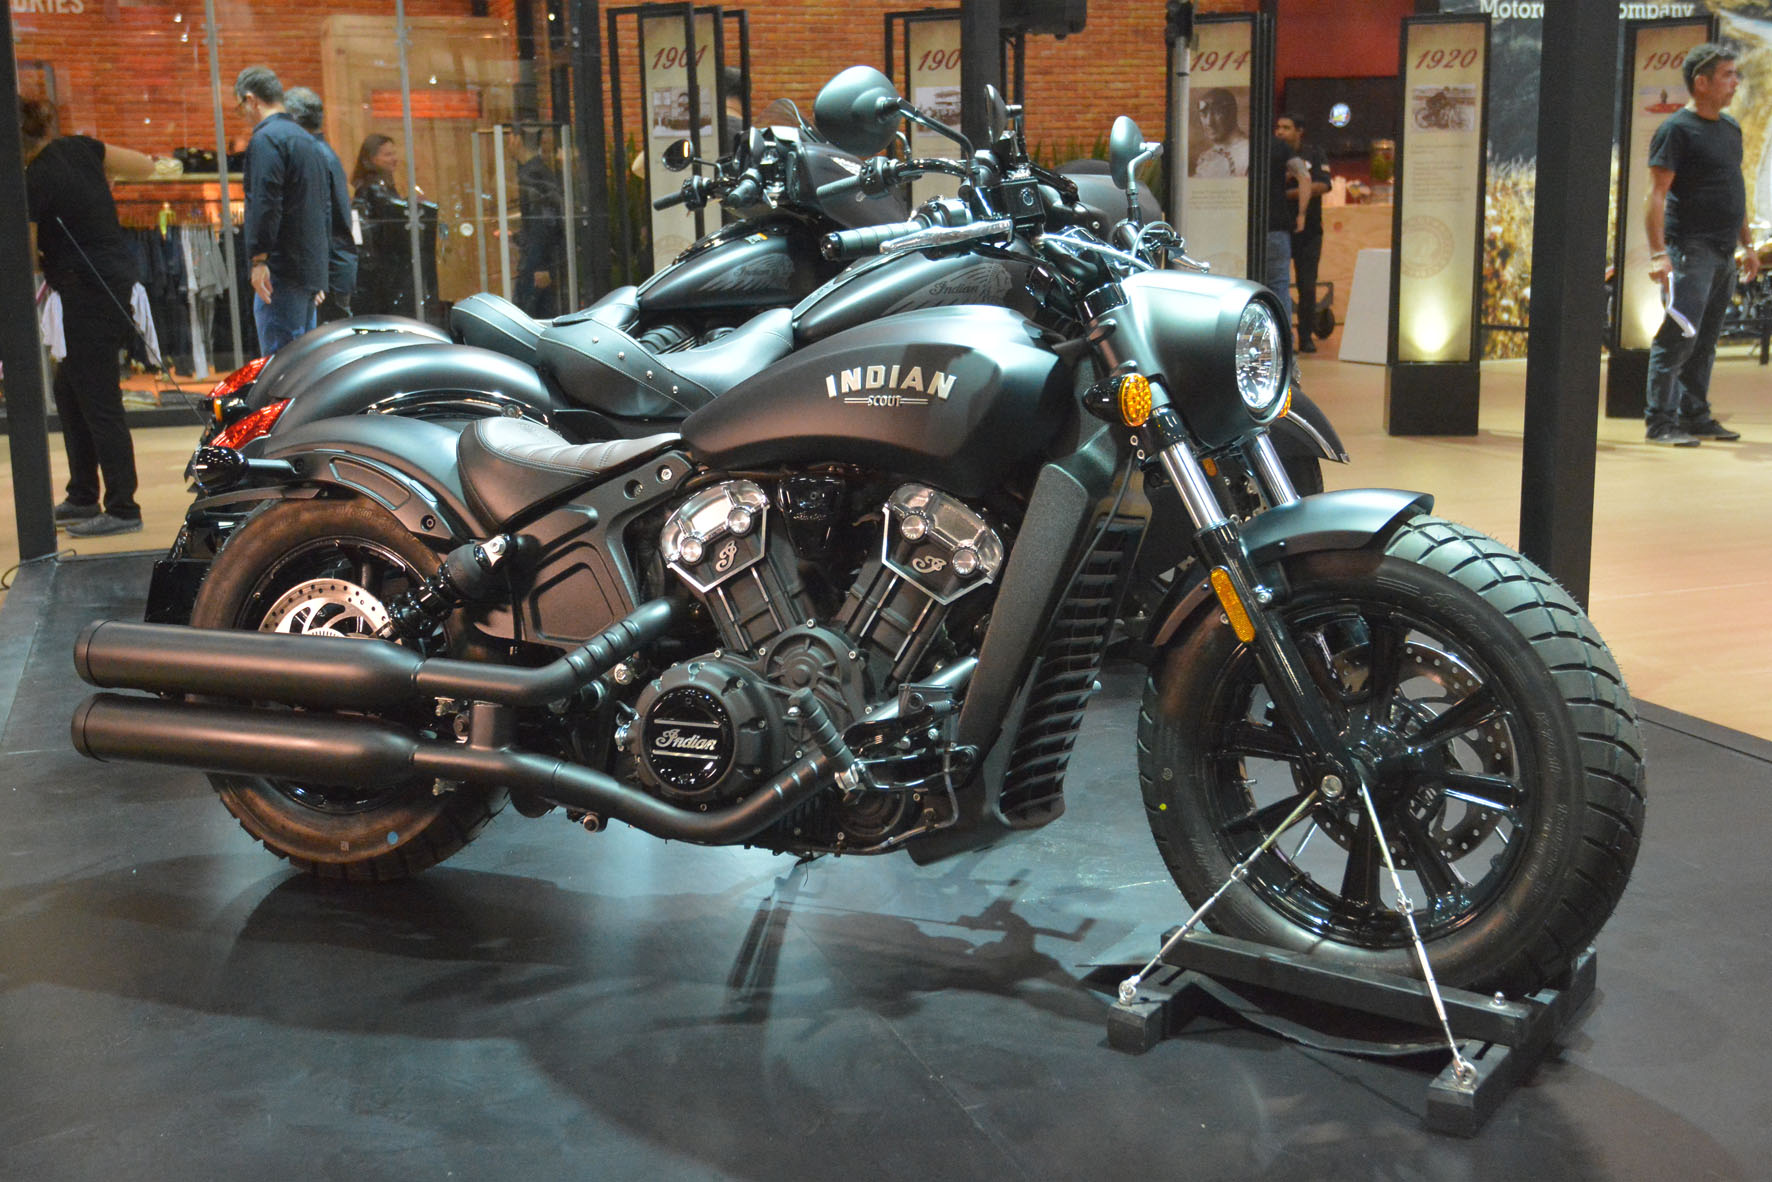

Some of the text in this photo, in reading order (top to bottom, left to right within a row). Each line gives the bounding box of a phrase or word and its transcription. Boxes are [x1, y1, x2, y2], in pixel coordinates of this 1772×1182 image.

[917, 47, 962, 72] 190
[1190, 49, 1250, 72] 1914
[1415, 47, 1478, 70] 1920
[1643, 50, 1689, 72] 196
[929, 281, 980, 296] Indian
[825, 364, 957, 400] INDIAN
[867, 394, 902, 407] SCOUT
[655, 728, 718, 751] Indian
